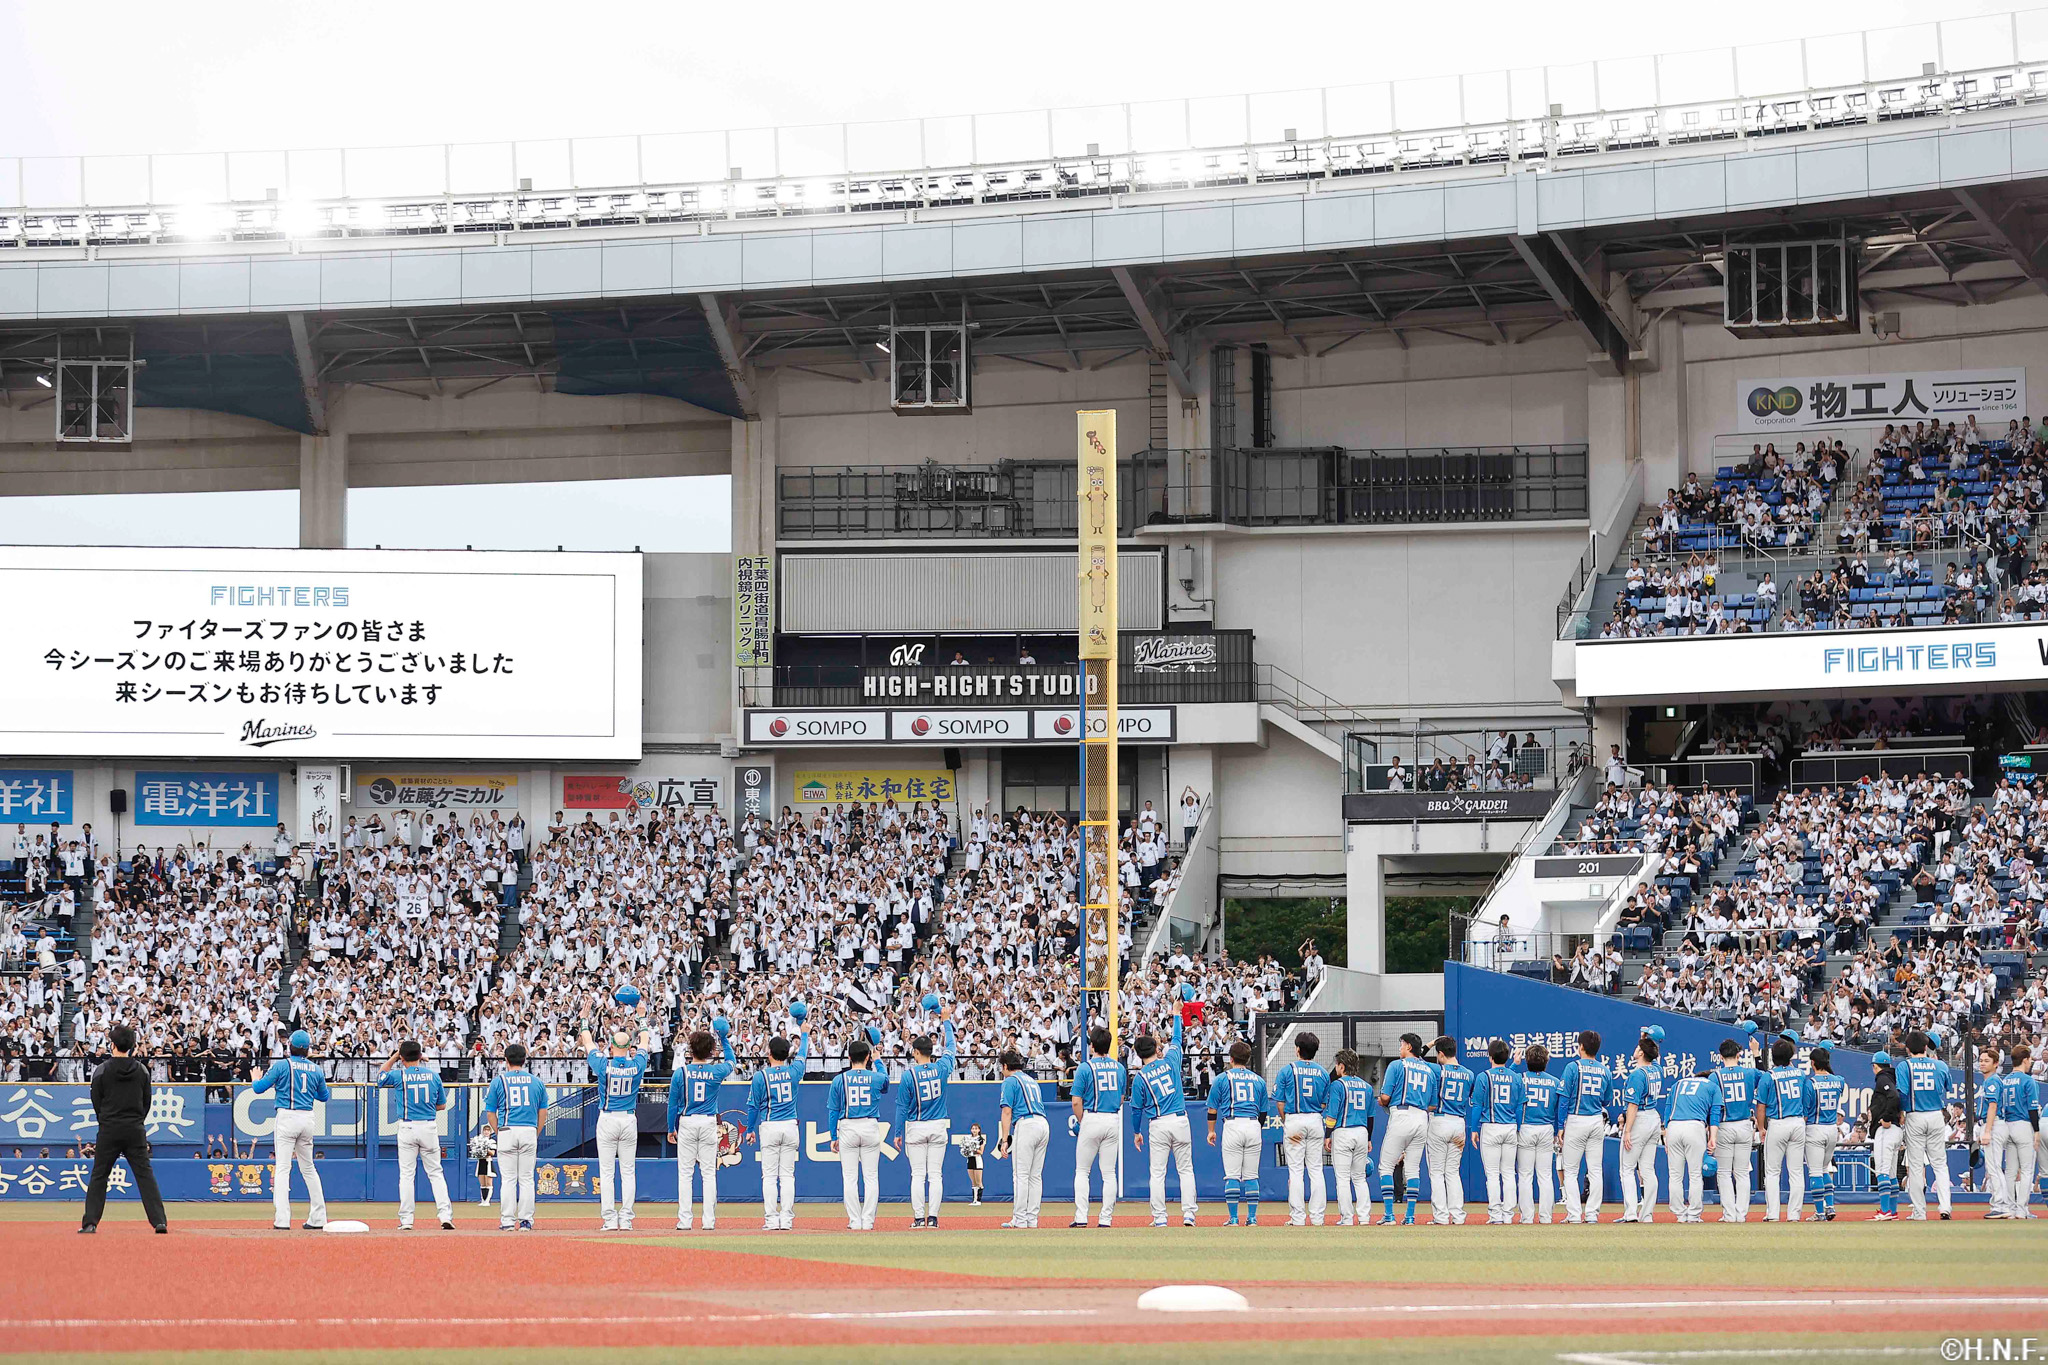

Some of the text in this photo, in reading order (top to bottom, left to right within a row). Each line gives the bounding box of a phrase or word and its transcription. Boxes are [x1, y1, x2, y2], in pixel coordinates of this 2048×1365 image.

[1756, 392, 1798, 411] KND
[1809, 379, 1930, 419] 物工人
[1933, 388, 2017, 404] ソリューション
[2001, 403, 2018, 411] 1964
[1754, 417, 1796, 425] Corporation
[211, 586, 349, 607] FIGHTERS
[738, 557, 753, 648] 内視鏡クリニック
[133, 618, 426, 642] ファイターズファンの皆さま
[43, 647, 514, 674] 今シーズンのご来場ありがとうございました
[1138, 639, 1213, 664] Marines
[1824, 642, 1996, 674] FIGHTERS
[115, 680, 443, 705] 来シーズンもお待ちしています
[239, 718, 317, 746] Marines
[797, 719, 867, 736] SOMPO
[938, 719, 1009, 735] SOMPO
[397, 787, 504, 805] 佐藤ケミカル
[655, 777, 718, 808] 広宣
[803, 790, 826, 799] EIWA
[856, 776, 951, 800] 永和住宅
[143, 780, 271, 818] 電洋社
[1427, 800, 1508, 814] BBQ GARDEN
[1578, 862, 1600, 874] 201
[406, 902, 422, 915] 26
[292, 1061, 316, 1072] SHINJO
[606, 1065, 638, 1076] MORIMOTO
[687, 1071, 714, 1080] ASAMA
[918, 1069, 939, 1080] ISHII
[1293, 1066, 1322, 1077] NOMURA
[1578, 1065, 1606, 1077] SUGIURA
[1721, 1072, 1745, 1081] GUNJI
[1911, 1062, 1936, 1071] TANAKA
[301, 1073, 308, 1094] 1
[403, 1073, 433, 1083] HAYASHI
[610, 1078, 633, 1096] 80
[769, 1072, 791, 1082] DAITA
[847, 1075, 872, 1085] YACHI
[1098, 1071, 1118, 1091] 20
[1150, 1074, 1175, 1097] 72
[1407, 1070, 1428, 1093] 44
[1491, 1074, 1512, 1083] TAMAI
[1581, 1075, 1601, 1096] 22
[1913, 1071, 1935, 1091] 26
[407, 1083, 430, 1104] 77
[510, 1086, 530, 1107] 81
[694, 1082, 706, 1102] 8
[770, 1082, 793, 1103] 79
[849, 1086, 871, 1107] 85
[919, 1079, 942, 1102] 38
[1235, 1081, 1255, 1102] 61
[1302, 1078, 1314, 1097] 5
[1445, 1081, 1464, 1102] 21
[1493, 1084, 1511, 1104] 19
[1527, 1087, 1549, 1108] 24
[1680, 1081, 1700, 1096] 13
[1724, 1082, 1746, 1103] 30
[1779, 1079, 1800, 1099] 46
[1348, 1090, 1366, 1110] 43
[1820, 1091, 1837, 1110] 56
